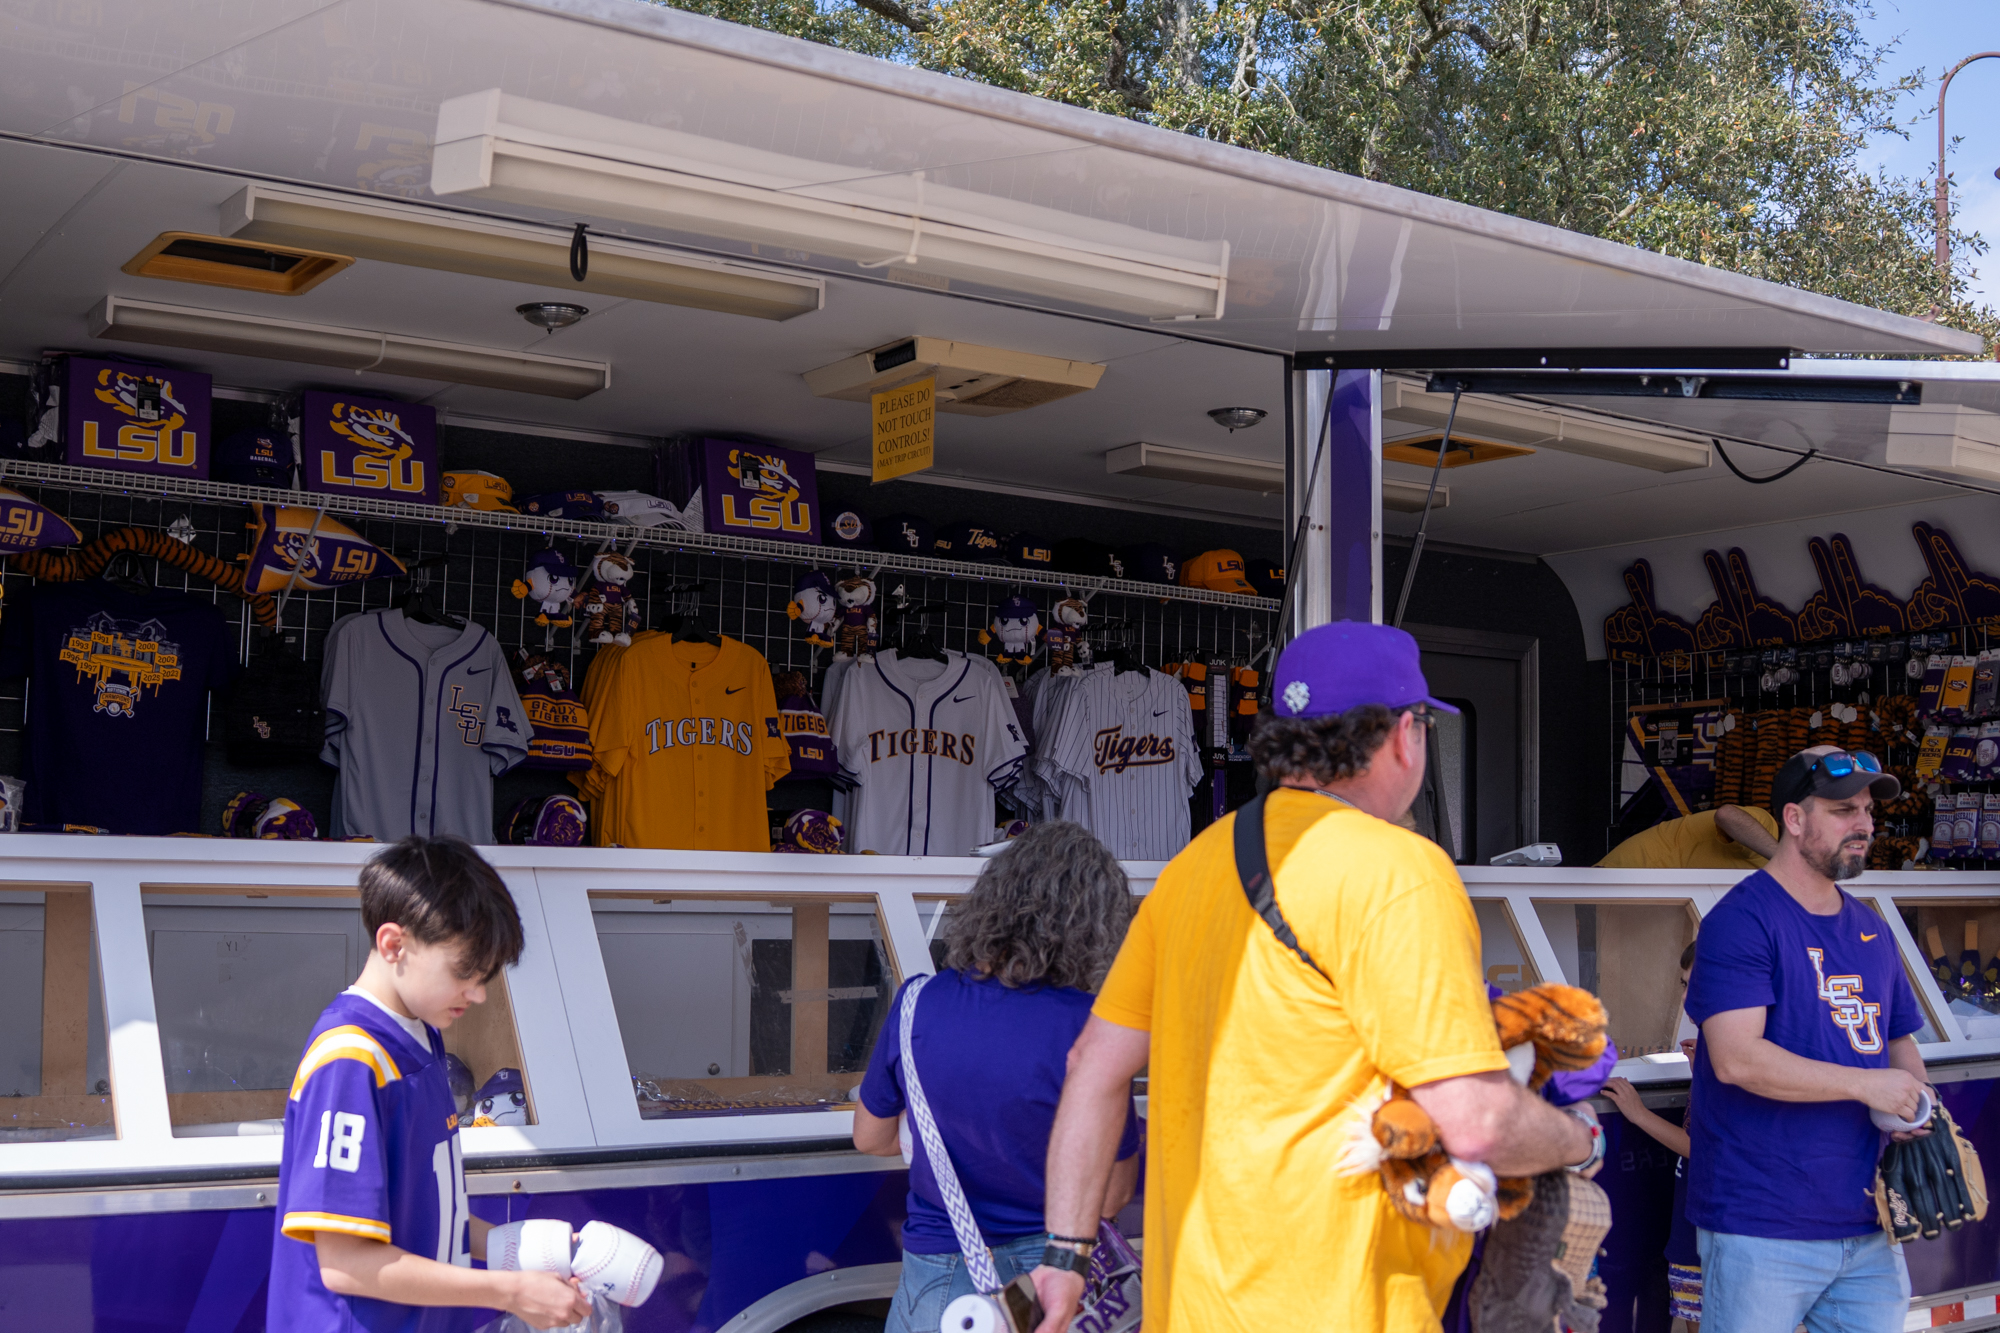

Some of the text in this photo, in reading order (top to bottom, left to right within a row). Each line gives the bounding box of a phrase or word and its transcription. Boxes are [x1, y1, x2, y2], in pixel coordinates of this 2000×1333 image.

[880, 387, 930, 414] PLEASE DO
[877, 407, 931, 435] NOT TOUCH
[83, 420, 197, 466] LSU
[878, 428, 930, 454] CONTROLS!
[255, 447, 273, 457] LSU
[877, 446, 931, 469] (MAY TRIP CIRCUIT)
[250, 455, 278, 464] BASEBALL
[321, 450, 425, 493] LSU
[484, 479, 508, 493] LSU
[565, 492, 593, 504] LSU
[647, 499, 673, 512] LSU
[721, 494, 811, 533] LSU
[902, 522, 919, 548] LSU
[332, 546, 378, 575] LSU
[1022, 546, 1051, 562] LSU
[1108, 553, 1125, 578] LSU
[1162, 555, 1176, 580] LSU
[1217, 560, 1244, 573] LSU
[328, 571, 371, 581] TIGERS
[606, 585, 621, 593] LSU
[628, 618, 639, 630] LSU
[71, 639, 89, 650] 1993
[93, 633, 110, 644] 1991
[137, 642, 156, 651] 2000
[62, 651, 80, 663] 1996
[157, 656, 175, 664] 2009
[80, 662, 98, 673] 1997
[162, 669, 179, 678] 2023
[142, 673, 161, 682] 2025
[1920, 684, 1940, 693] LSU
[447, 684, 487, 746] LSU
[531, 701, 576, 716] GEAUX
[529, 709, 578, 723] TIGERS
[253, 715, 271, 739] LSU
[645, 717, 753, 756] TIGERS
[541, 743, 576, 757] LSU
[799, 746, 824, 761] LSU
[868, 728, 976, 766] TIGERS
[1094, 724, 1176, 775] Tigers
[1945, 747, 1972, 758] LSU
[1807, 947, 1884, 1055] LSU
[313, 1110, 366, 1173] 18
